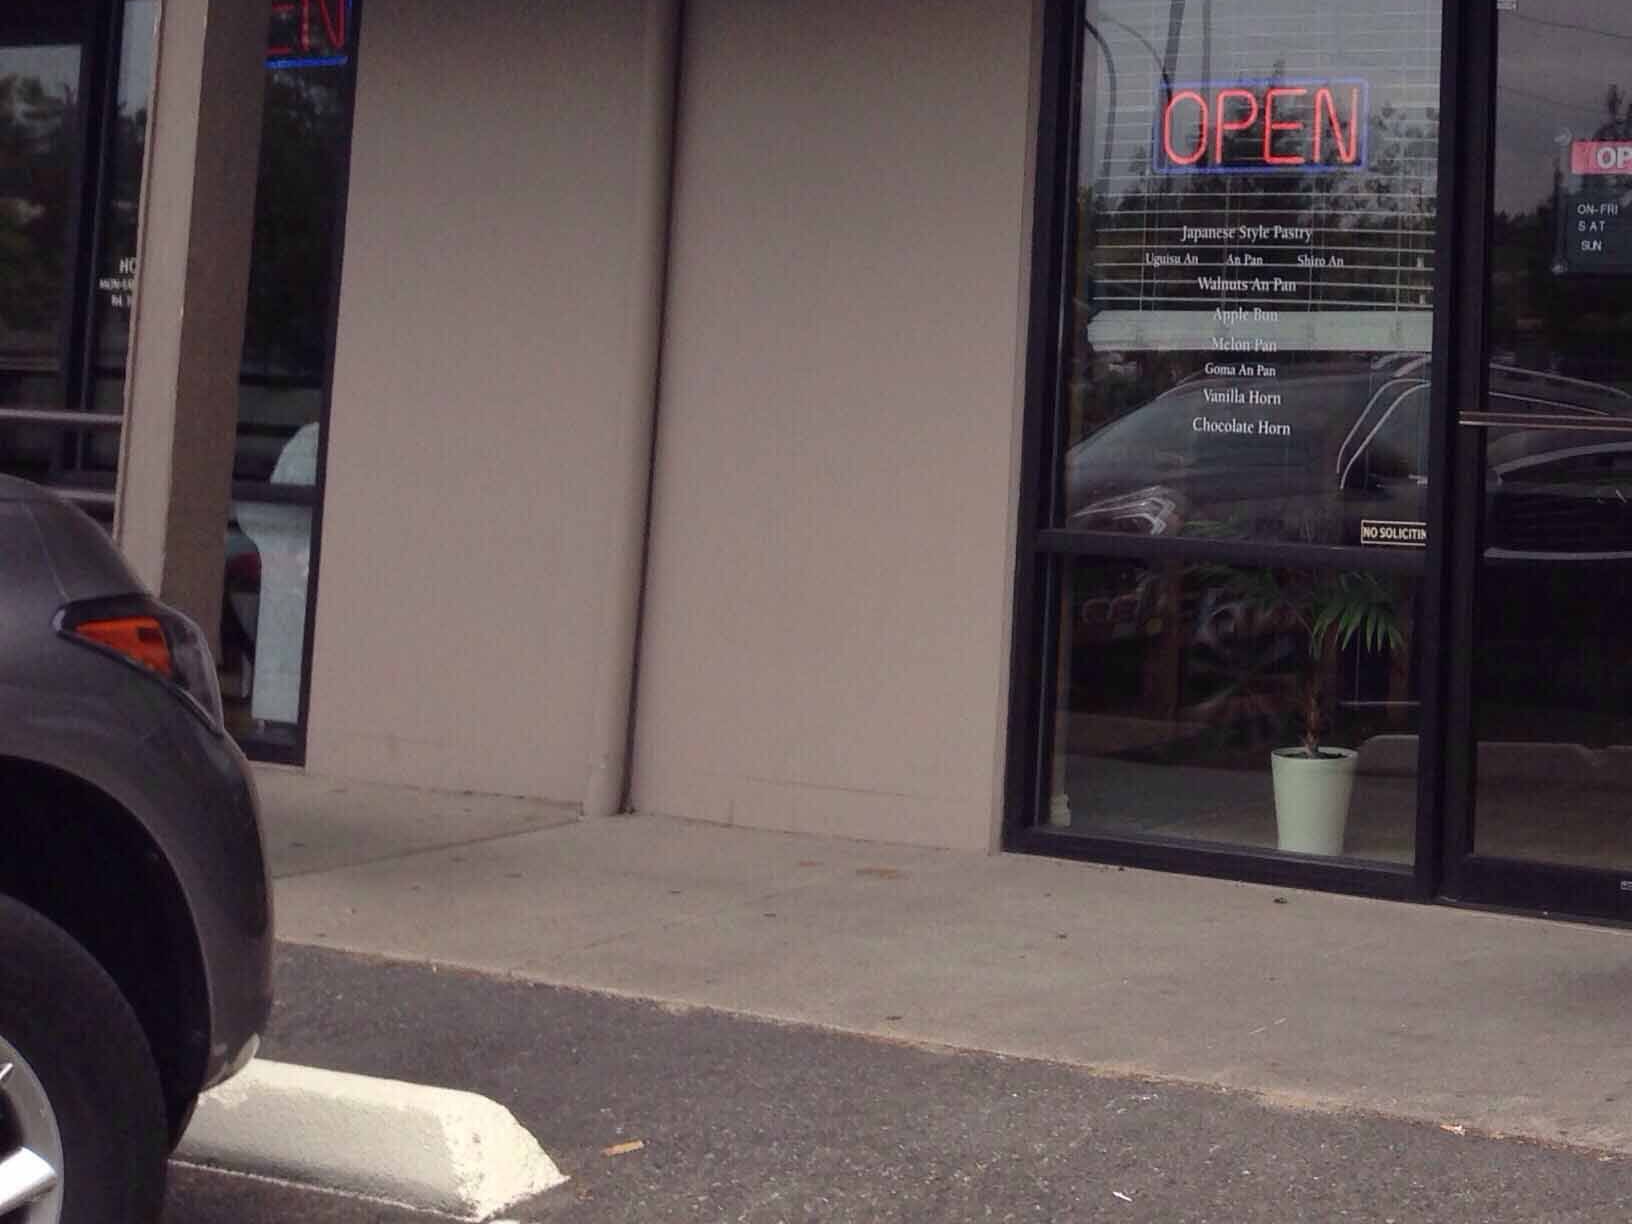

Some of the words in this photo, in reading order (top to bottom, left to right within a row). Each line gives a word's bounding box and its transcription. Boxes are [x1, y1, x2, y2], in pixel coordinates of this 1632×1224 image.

[1164, 87, 1359, 165] OPEN
[1181, 226, 1235, 241] Japanese
[1239, 226, 1271, 241] Style
[1274, 227, 1313, 242] Pastry
[1581, 240, 1602, 252] SUN
[1184, 253, 1199, 265] An
[1227, 254, 1240, 265] An
[1244, 254, 1264, 266] Pan
[1297, 255, 1326, 268] Shiro
[1328, 256, 1344, 267] An
[1197, 277, 1249, 291] Walnuts
[1251, 278, 1270, 291] An
[1273, 278, 1297, 292] Pan
[1213, 307, 1249, 322] Apple
[1253, 308, 1279, 321] Bun
[1254, 339, 1278, 353] Pan
[1205, 362, 1235, 376] Goma
[1238, 363, 1254, 376] An
[1257, 364, 1276, 377] Pan
[1203, 389, 1245, 404] Vanilla
[1249, 390, 1281, 405] Horn
[1192, 417, 1254, 433] Chocolate
[1257, 419, 1290, 435] Horn
[1363, 527, 1378, 538] NO
